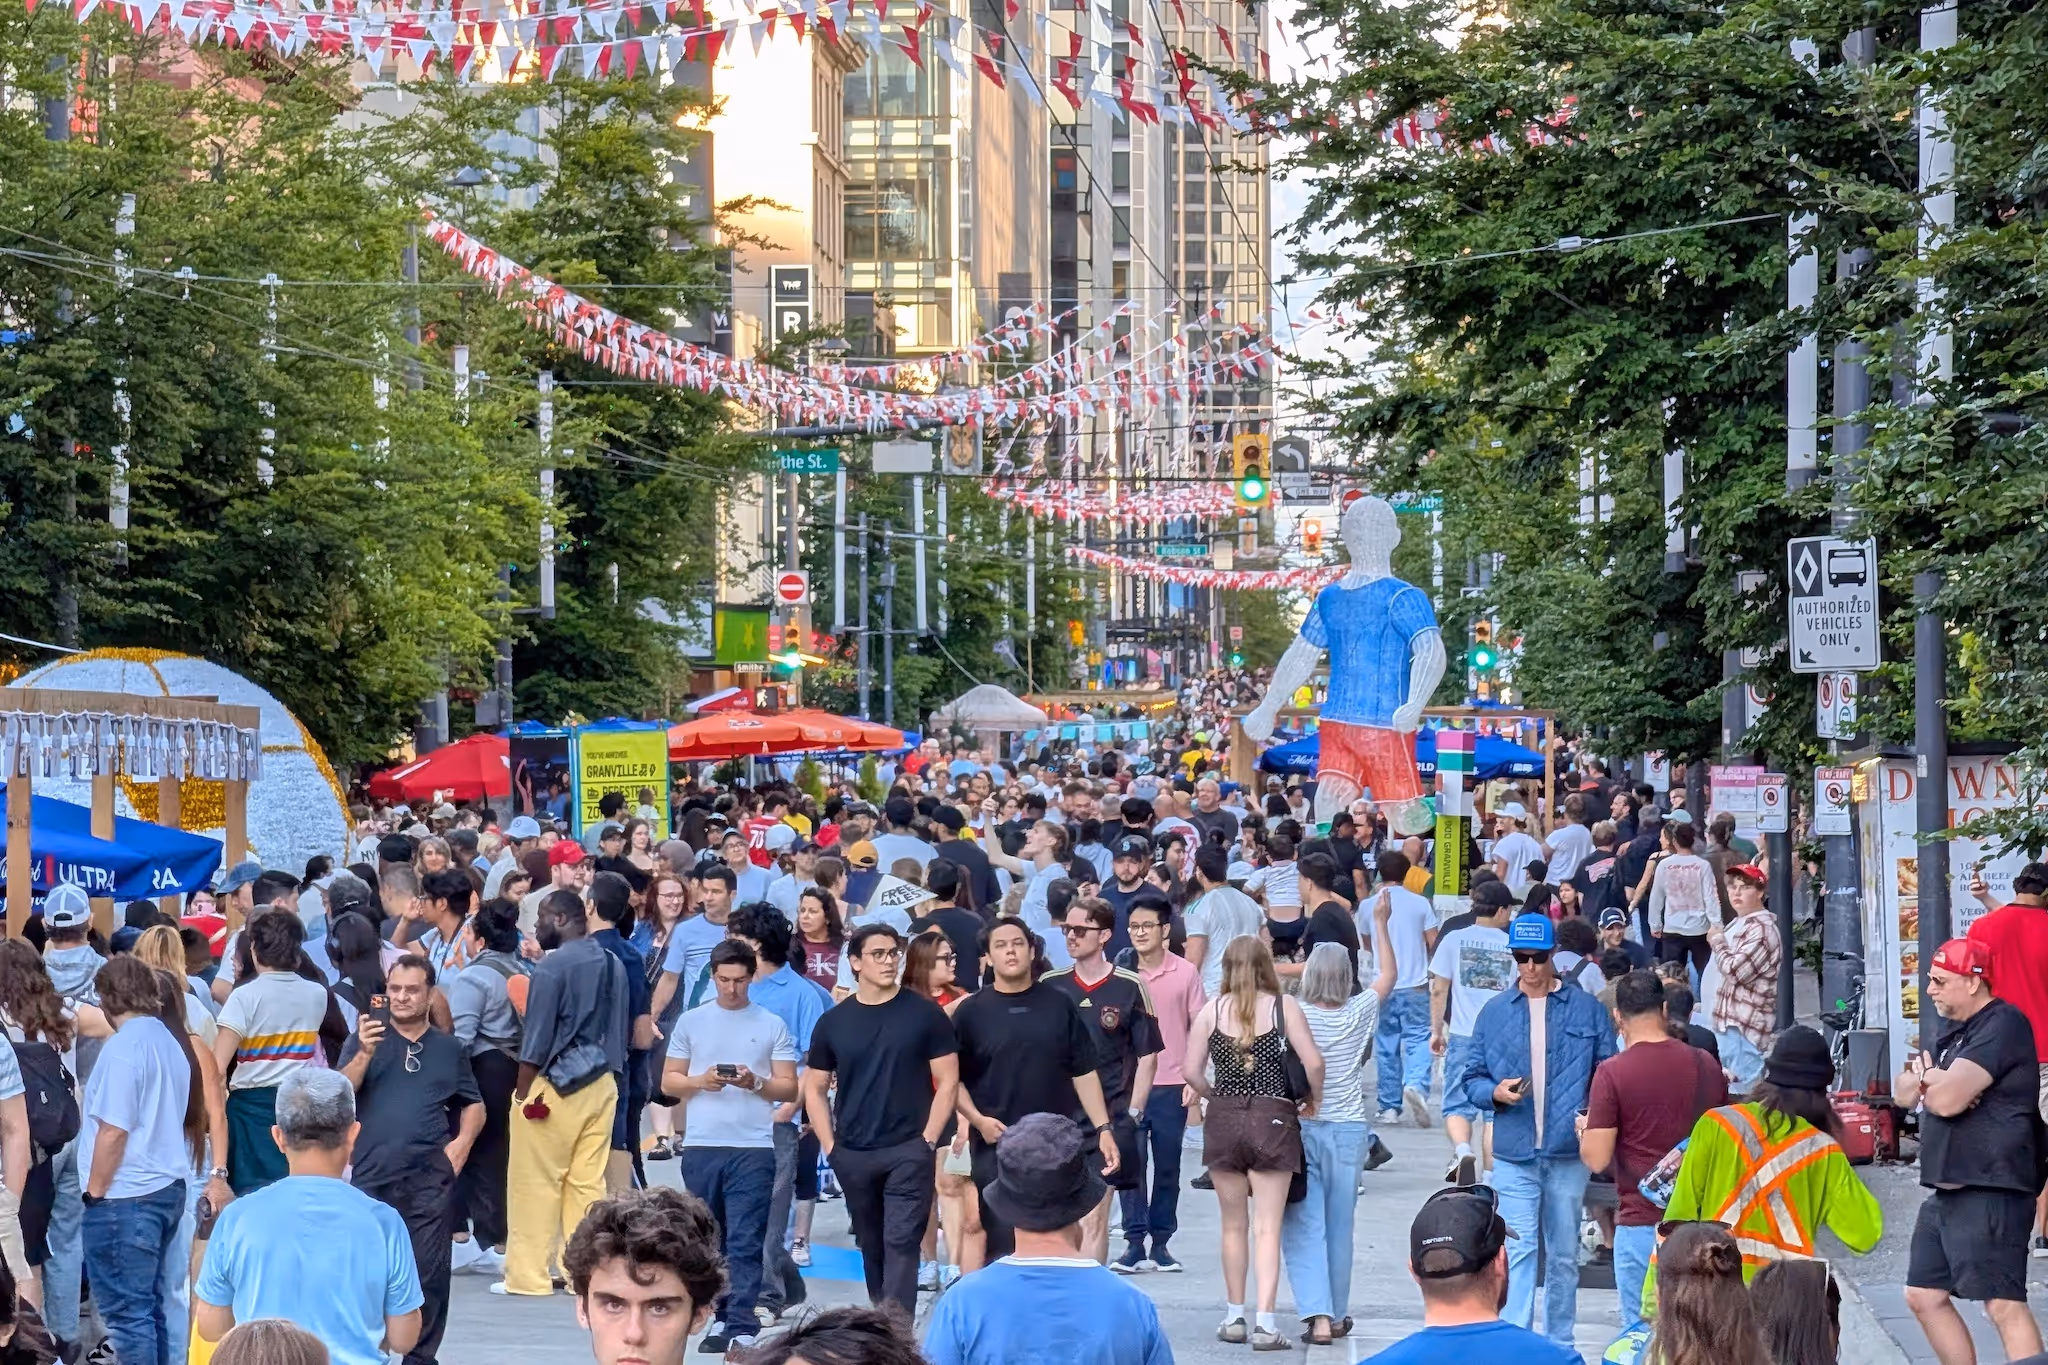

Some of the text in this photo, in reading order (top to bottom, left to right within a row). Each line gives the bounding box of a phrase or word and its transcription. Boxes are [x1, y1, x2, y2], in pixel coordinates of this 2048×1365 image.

[807, 453, 828, 469] St.
[1797, 600, 1871, 615] AUTHORIZED
[1807, 617, 1862, 630] VEHICLES
[1820, 632, 1850, 646] ONLY
[587, 764, 638, 778] GRANVILLE
[1443, 842, 1452, 890] GRANVILLE
[59, 862, 116, 892] ULTRA
[881, 883, 915, 902] FREE
